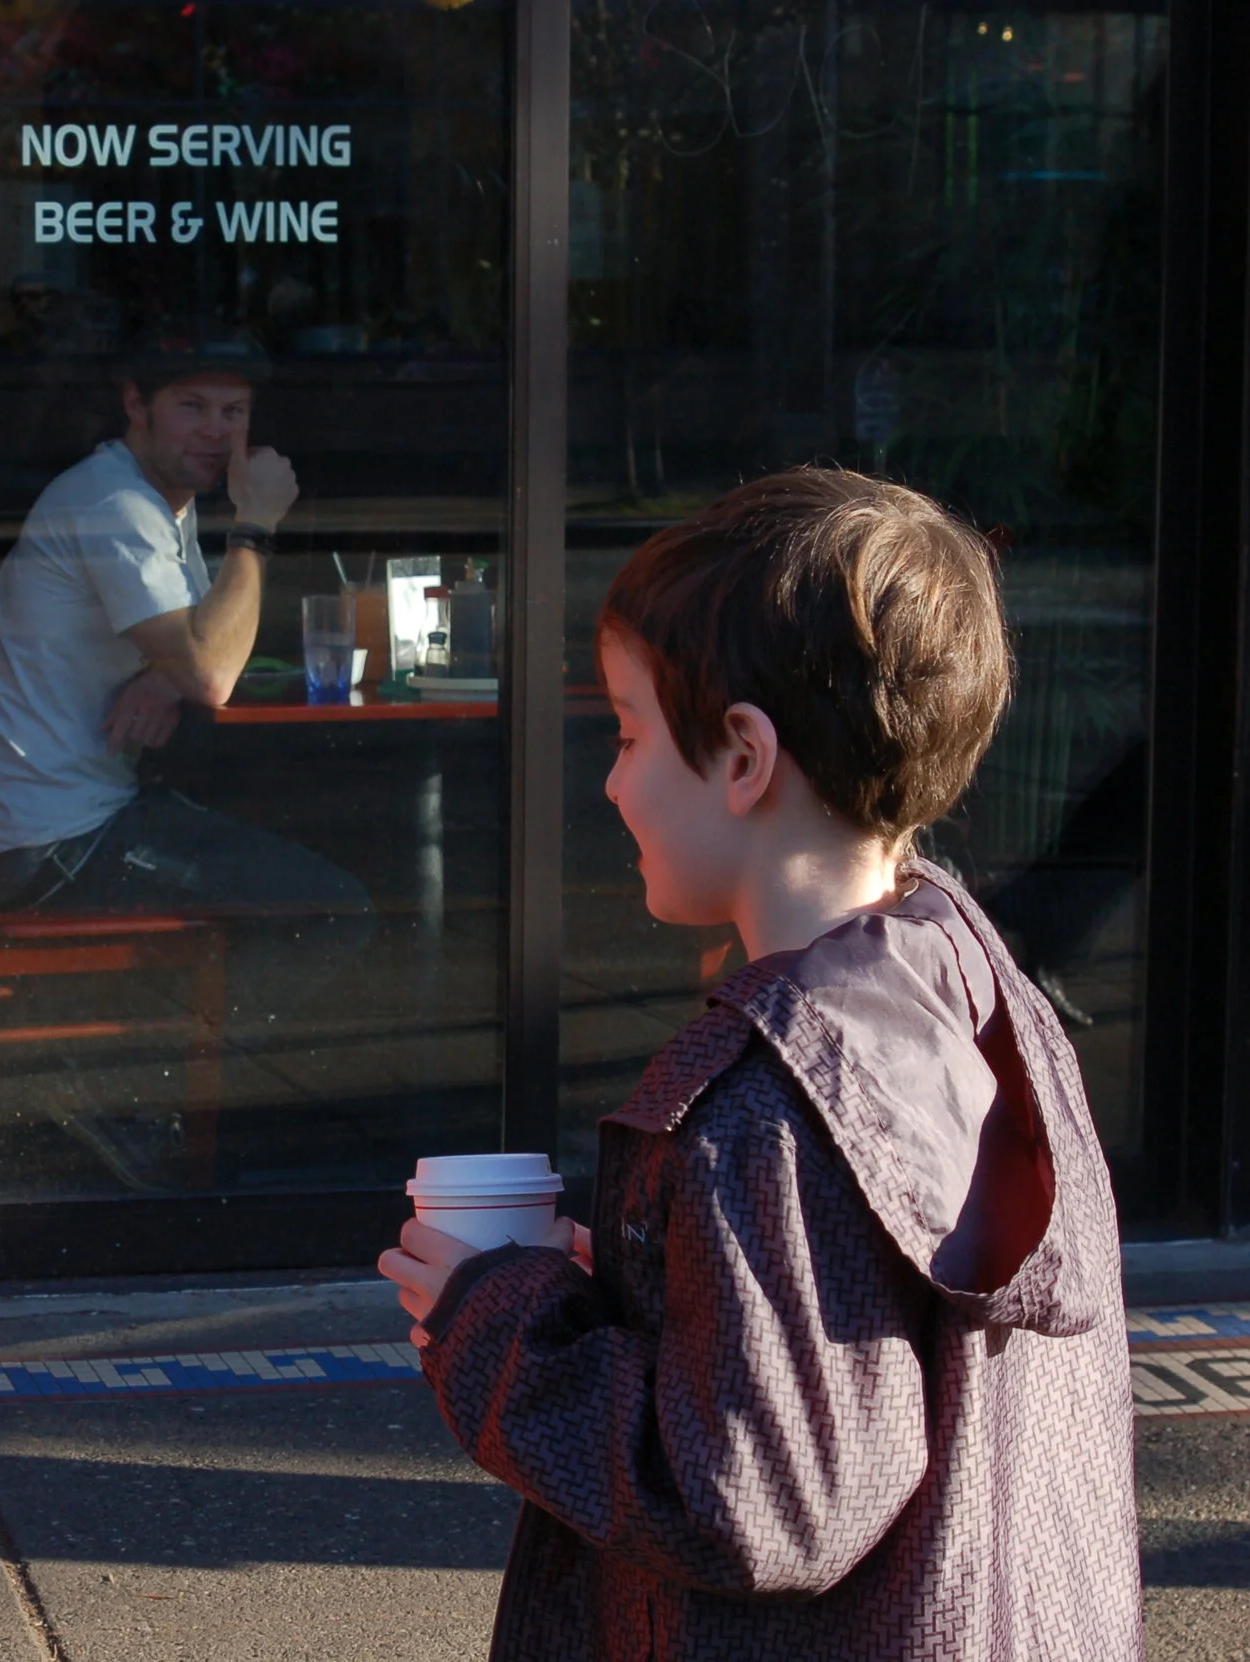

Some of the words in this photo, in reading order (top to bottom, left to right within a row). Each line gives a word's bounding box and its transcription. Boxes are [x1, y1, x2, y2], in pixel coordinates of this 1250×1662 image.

[21, 124, 137, 167] NOW
[148, 124, 352, 167] SERVING
[34, 201, 157, 243] BEER
[170, 201, 204, 243] &
[215, 201, 339, 243] WINE
